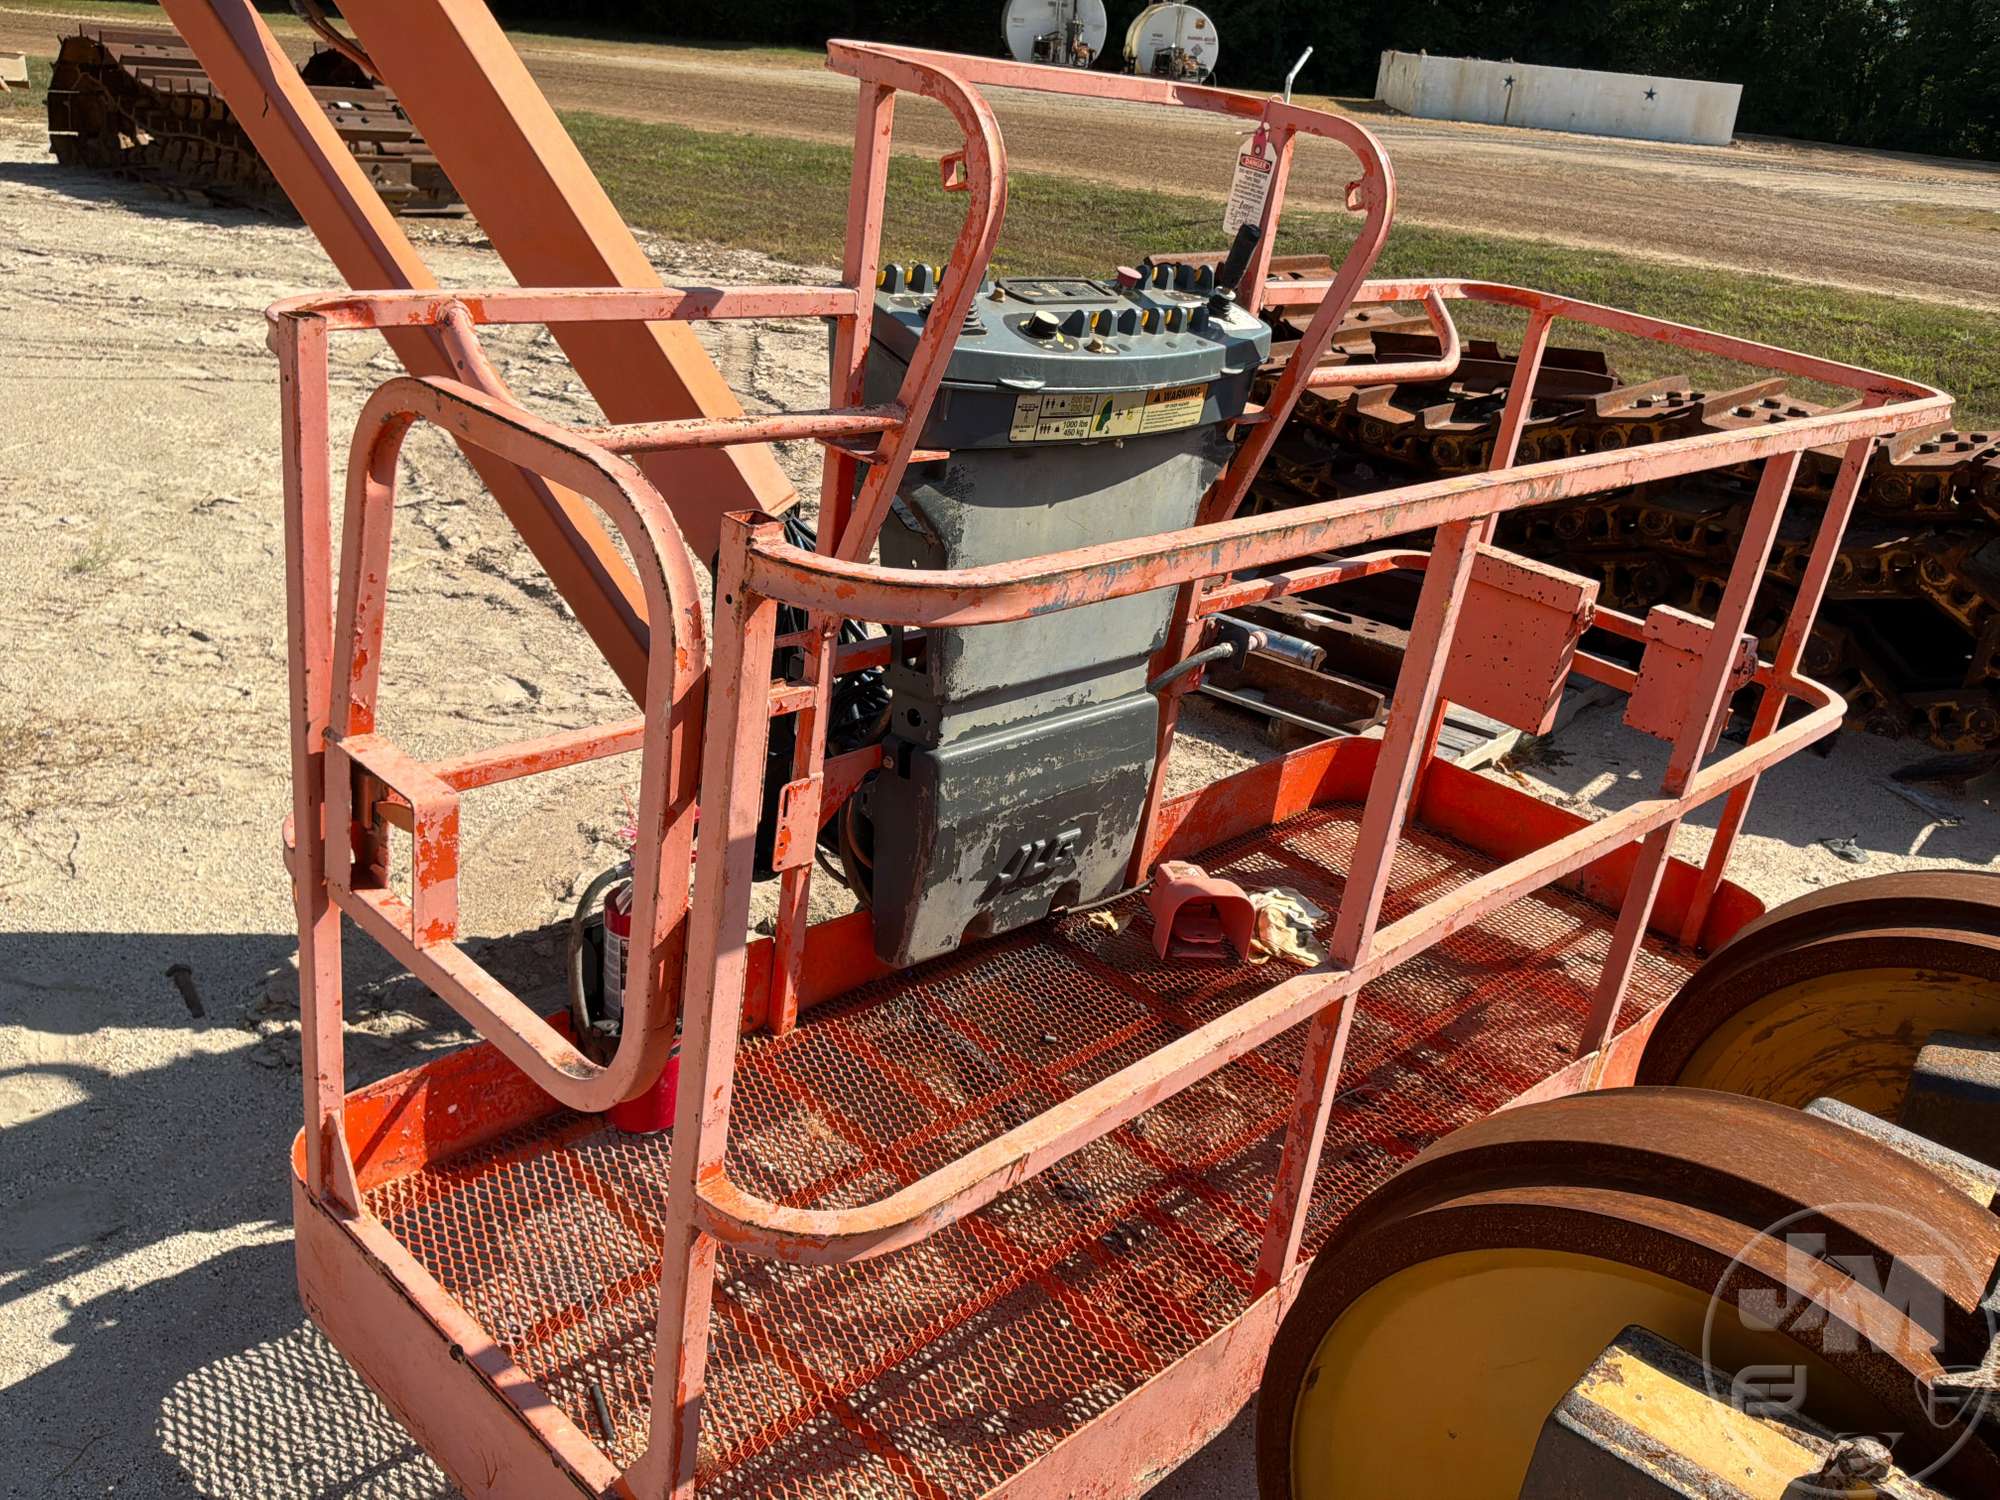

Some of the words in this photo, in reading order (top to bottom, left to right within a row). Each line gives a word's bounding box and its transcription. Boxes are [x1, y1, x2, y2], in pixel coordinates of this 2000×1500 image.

[1244, 158, 1267, 169] DANGER
[1164, 387, 1201, 401] WARNING
[1063, 420, 1078, 429] 1000
[1079, 420, 1089, 428] lbs
[1076, 428, 1085, 438] kg
